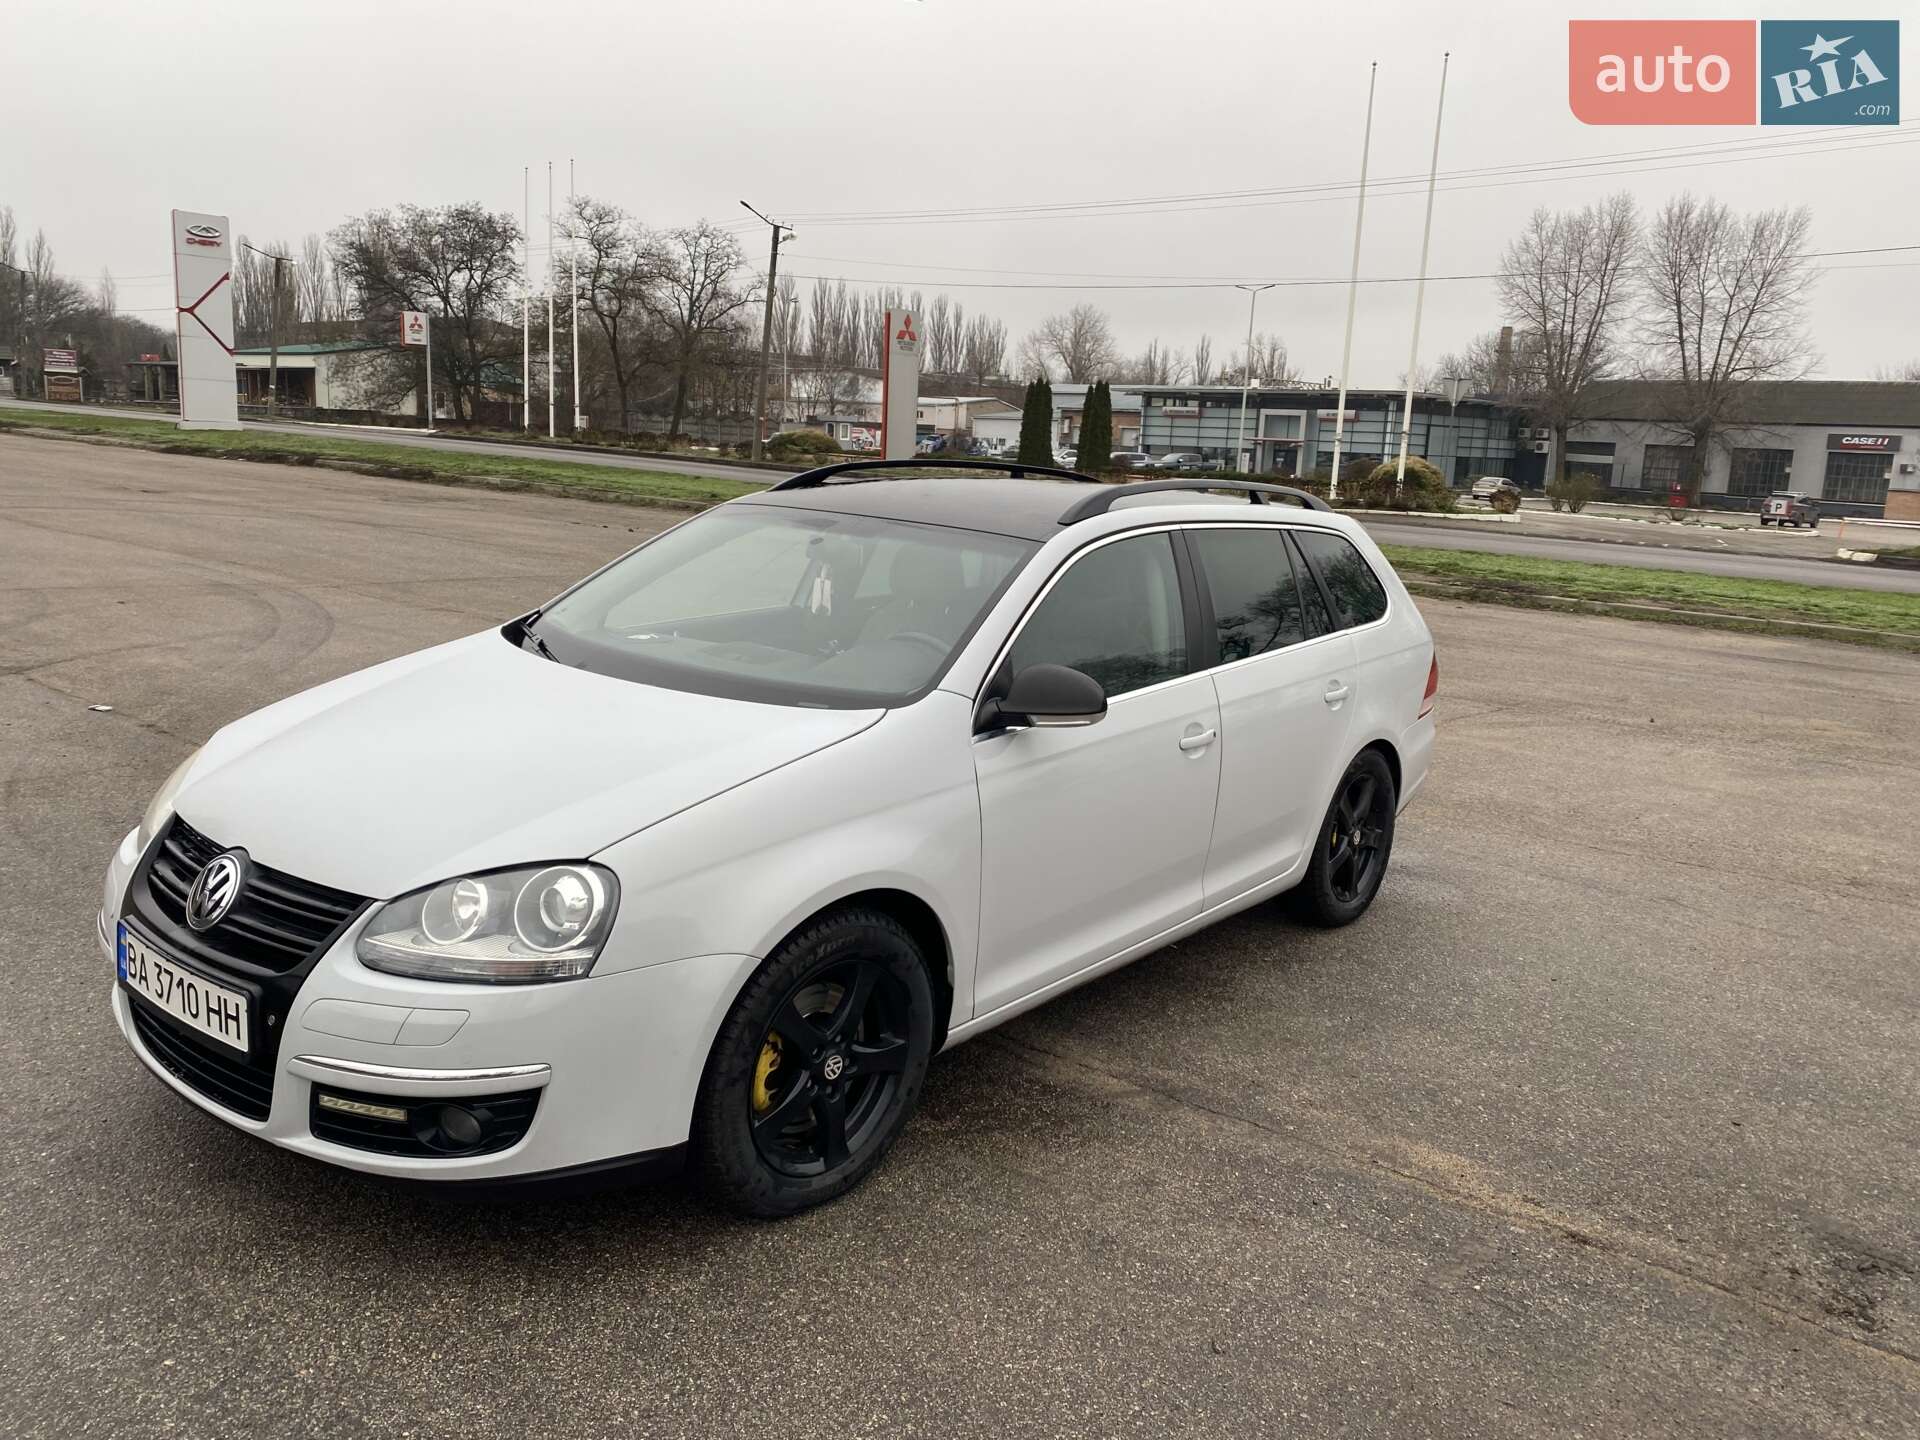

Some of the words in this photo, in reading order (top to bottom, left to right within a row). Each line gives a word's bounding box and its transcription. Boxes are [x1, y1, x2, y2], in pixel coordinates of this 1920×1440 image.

[1842, 437, 1877, 445] CASE
[1775, 503, 1782, 512] P
[128, 941, 149, 991] BA
[154, 961, 199, 1018] 3710
[205, 990, 241, 1040] HH
